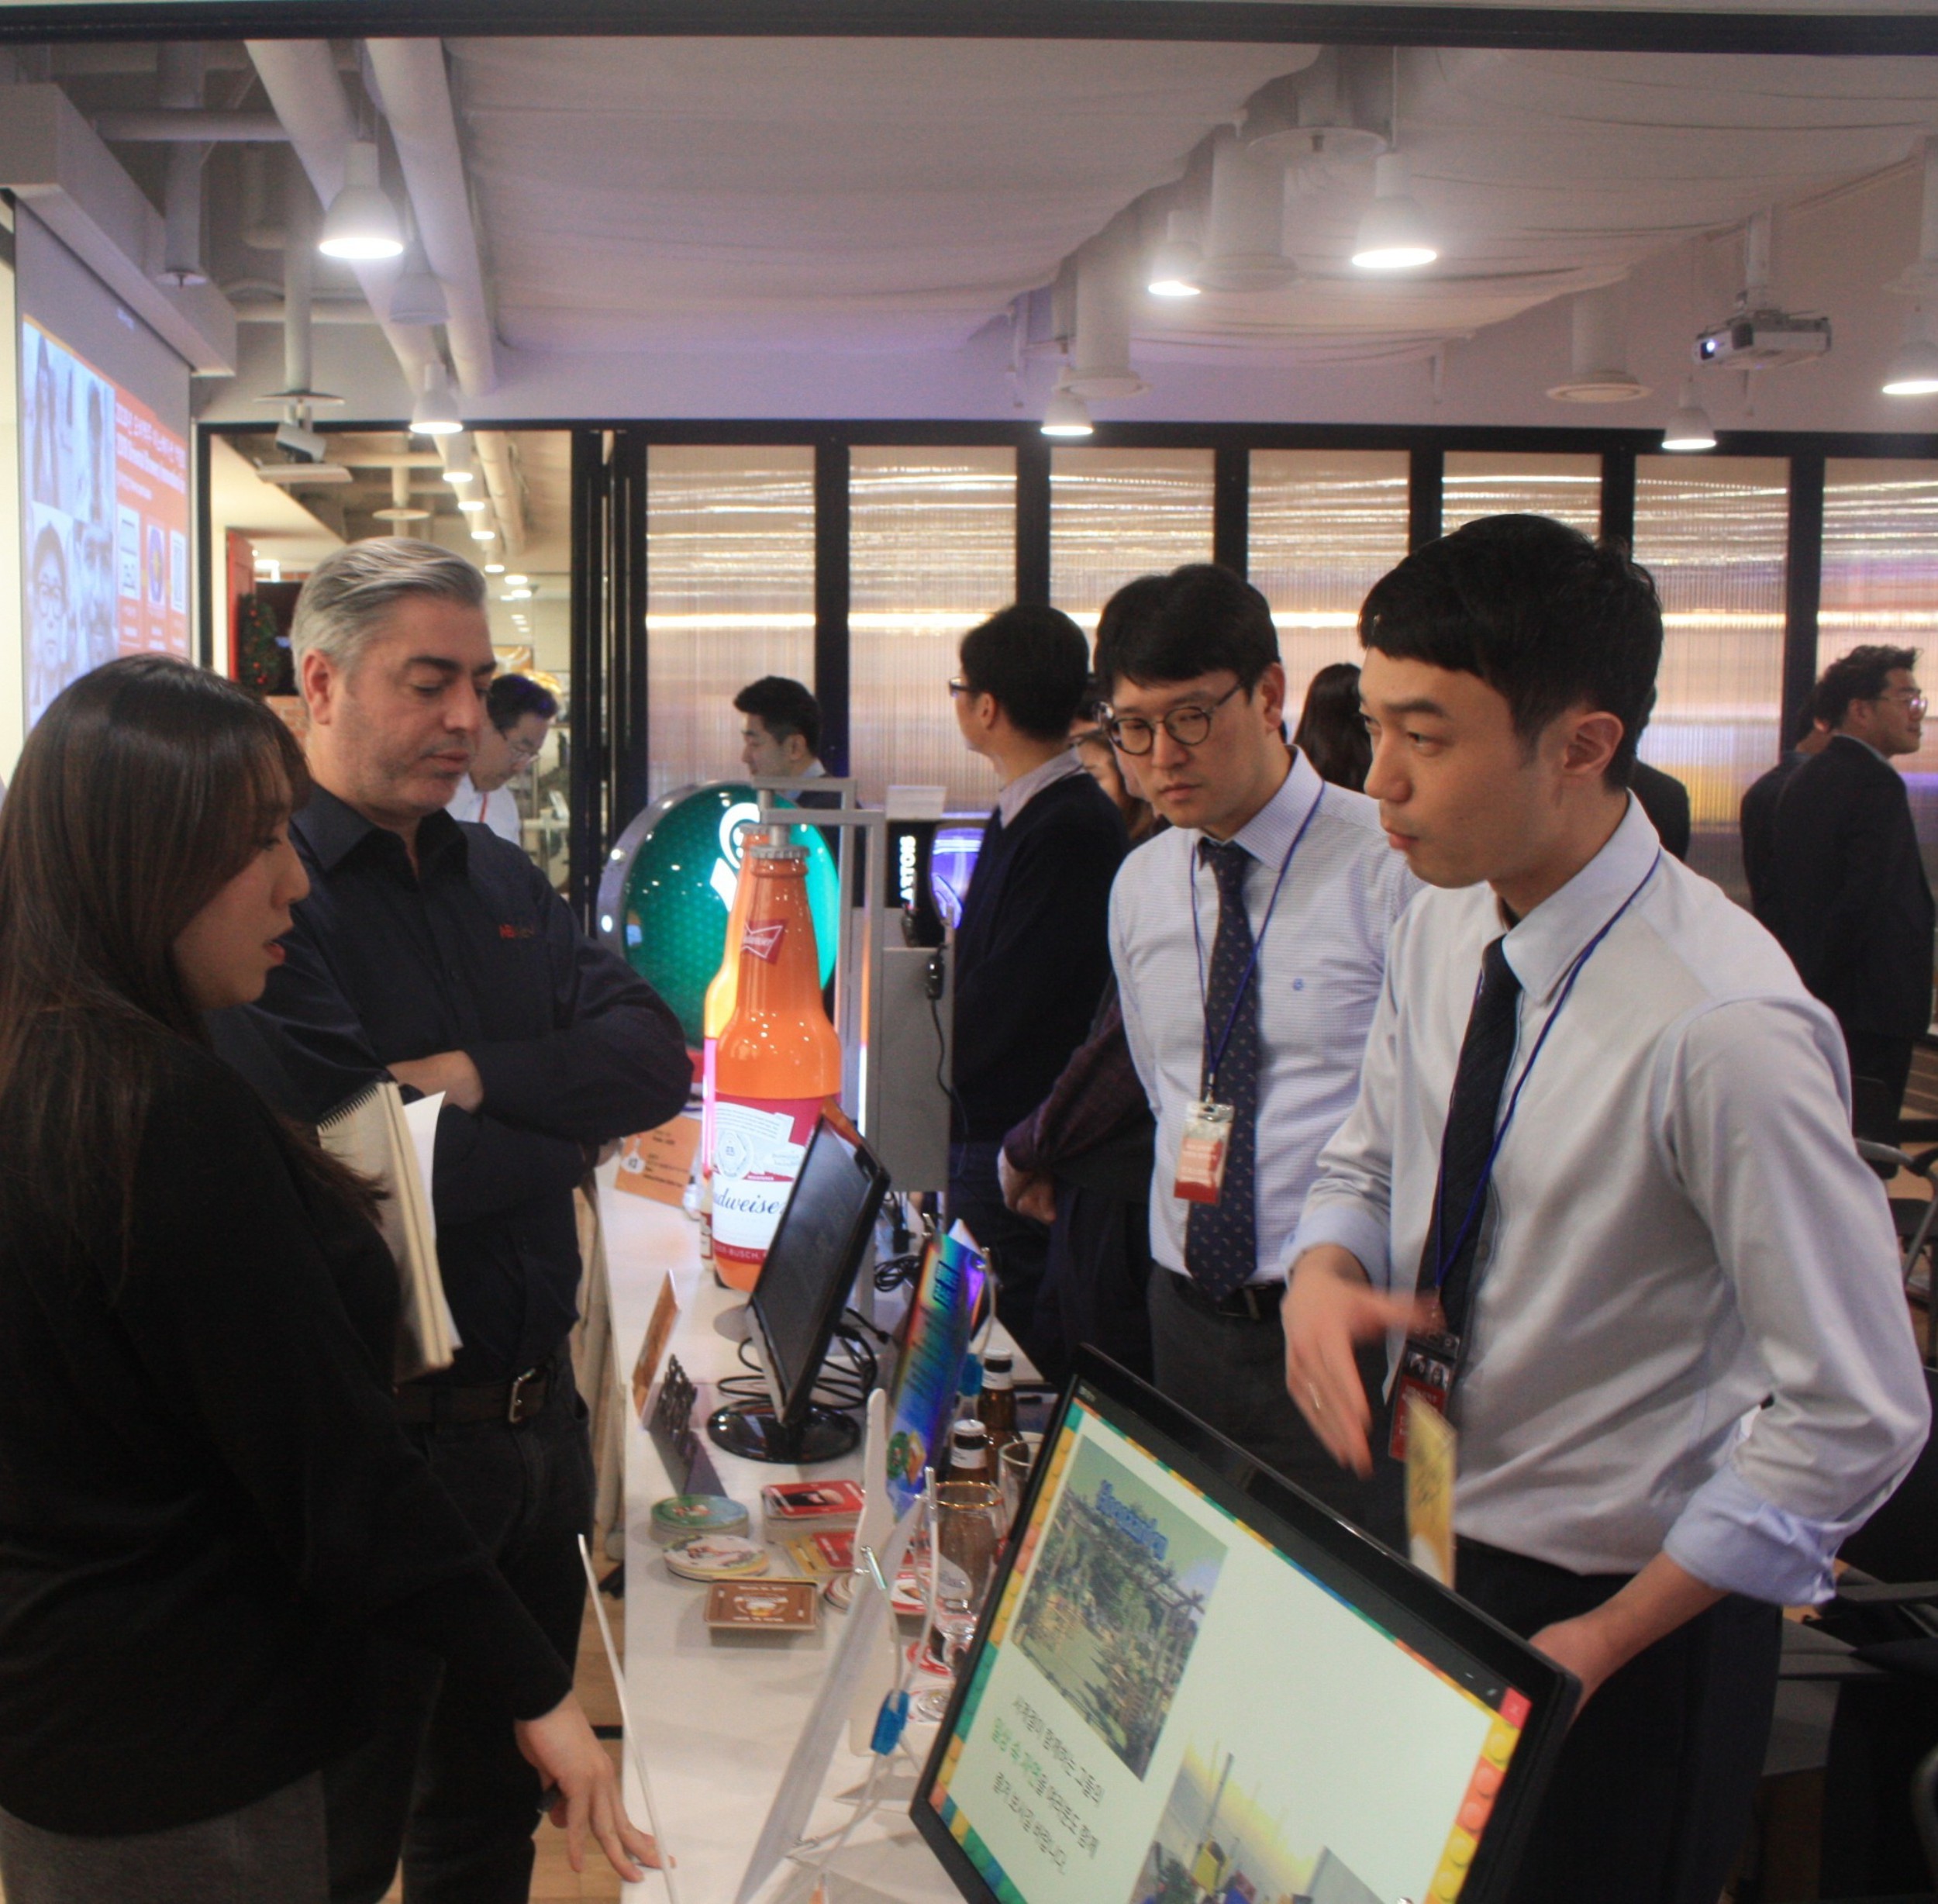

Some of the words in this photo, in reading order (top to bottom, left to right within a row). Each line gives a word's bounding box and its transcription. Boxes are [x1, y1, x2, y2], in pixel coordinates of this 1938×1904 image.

[1042, 1727, 1076, 1778] 함께하는
[1046, 1784, 1081, 1837] 여러분도
[1077, 1823, 1099, 1859] 함께
